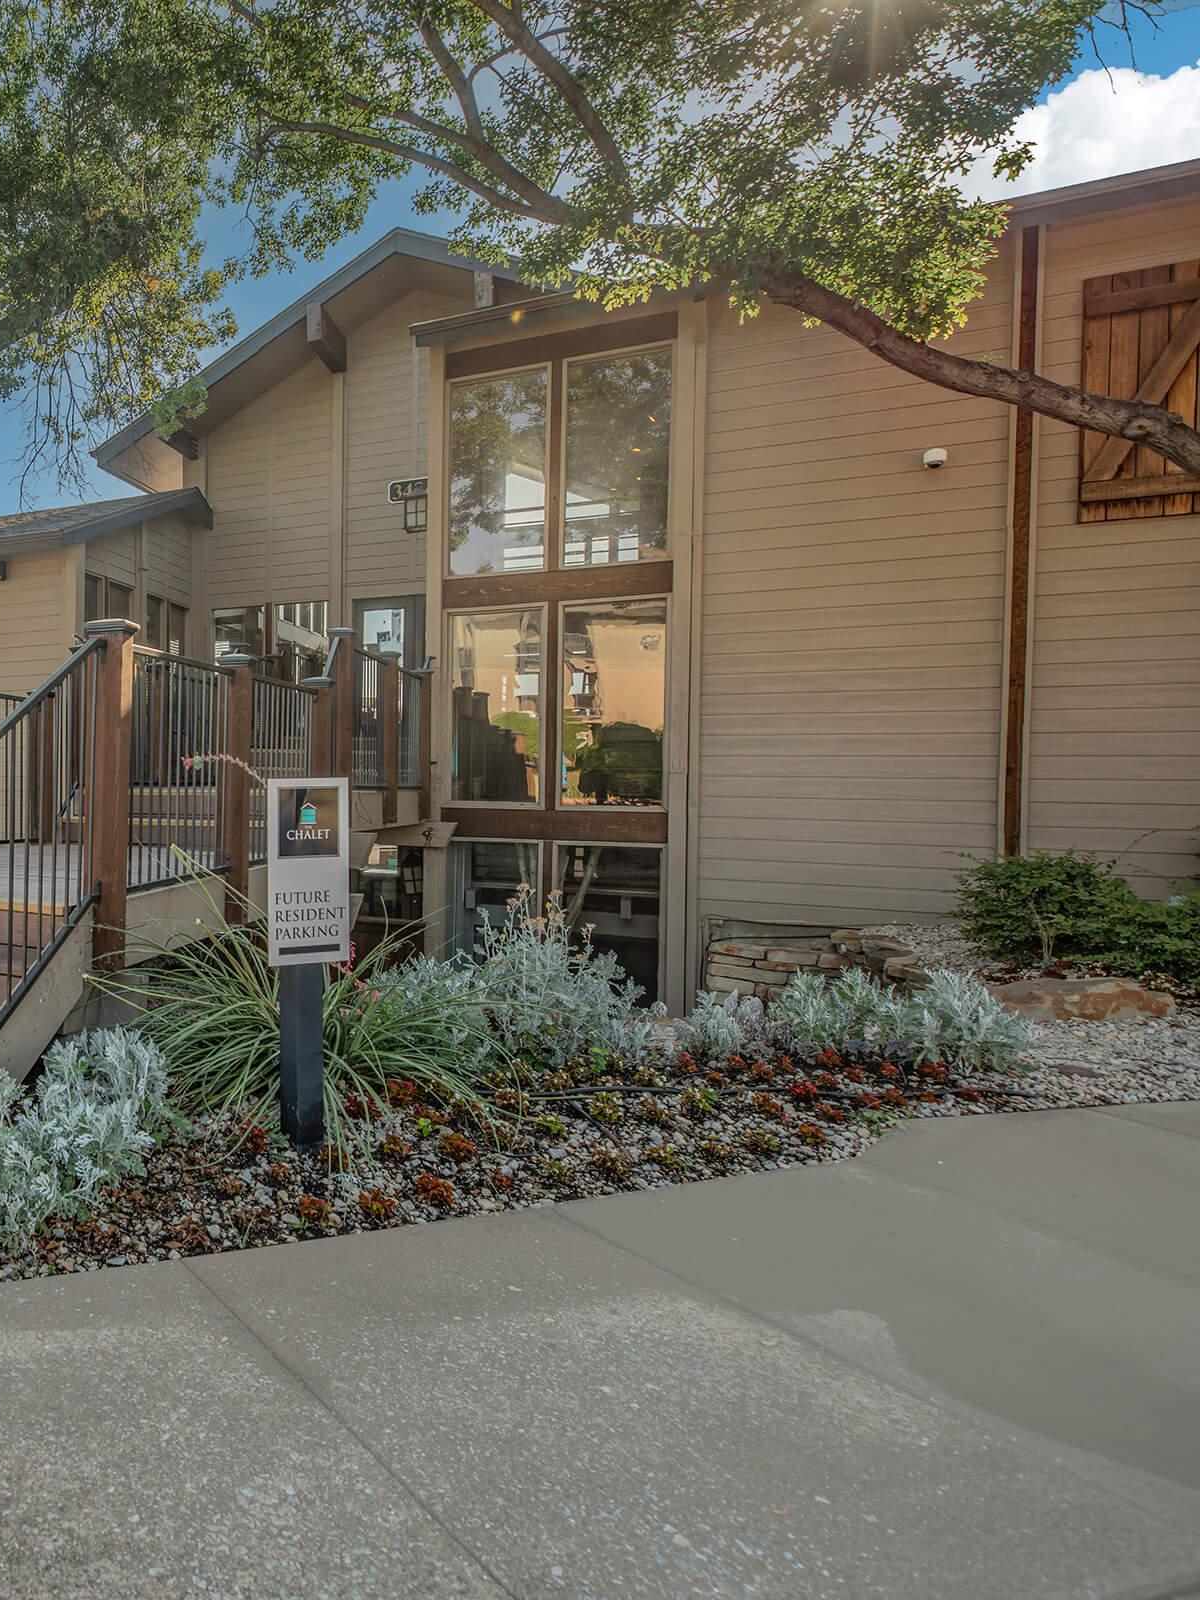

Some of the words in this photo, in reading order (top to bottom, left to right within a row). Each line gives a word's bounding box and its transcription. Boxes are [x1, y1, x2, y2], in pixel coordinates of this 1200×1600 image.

[287, 829, 330, 840] CHALET
[275, 890, 330, 905] FUTURE
[275, 907, 346, 922] RESIDENT
[275, 924, 339, 940] PARKING
